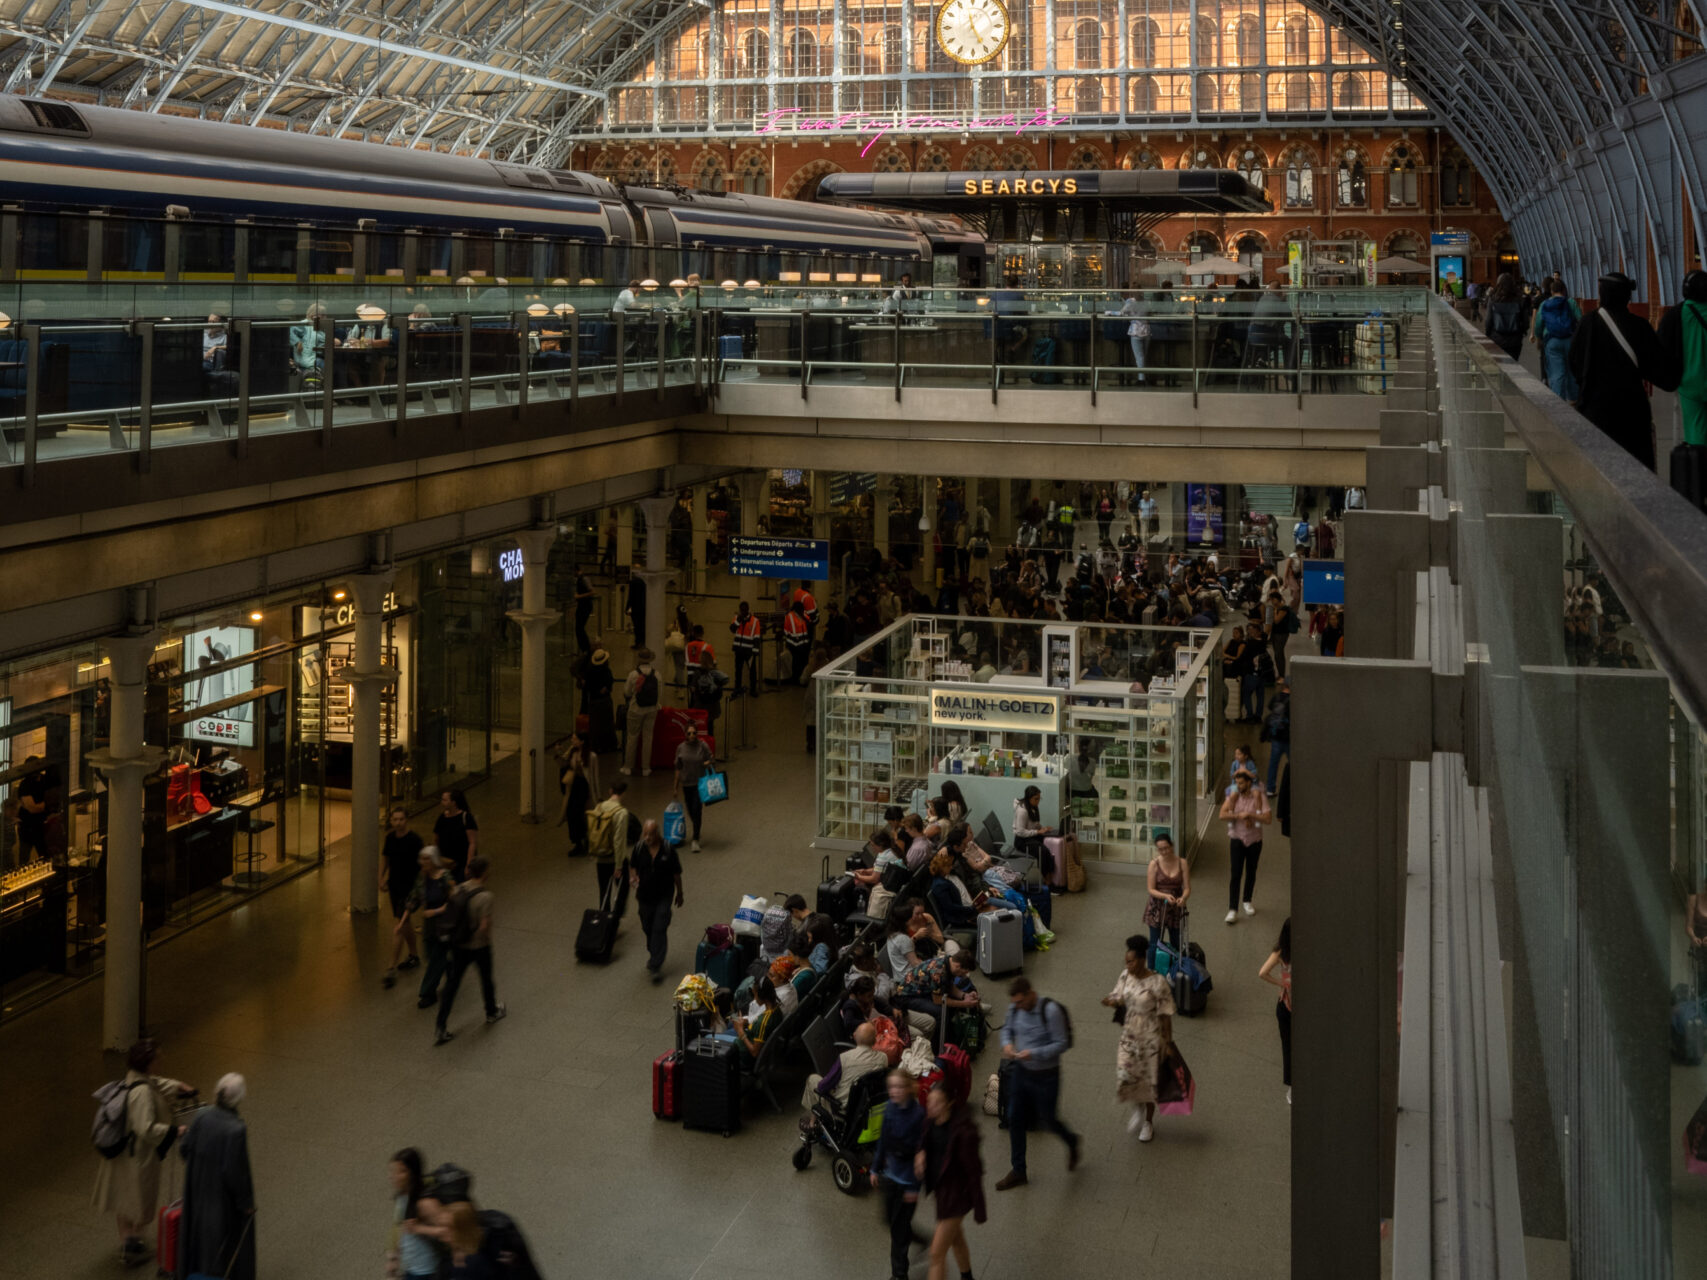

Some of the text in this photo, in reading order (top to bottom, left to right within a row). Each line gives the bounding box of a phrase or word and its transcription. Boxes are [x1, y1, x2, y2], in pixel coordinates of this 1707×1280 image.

[756, 108, 801, 134] I
[964, 178, 1078, 194] SEARCYS
[740, 539, 770, 547] Departures
[740, 548, 776, 557] Underground
[740, 558, 774, 566] International
[934, 696, 1055, 715] (MALIN+GOETZ)
[934, 709, 987, 722] new york.
